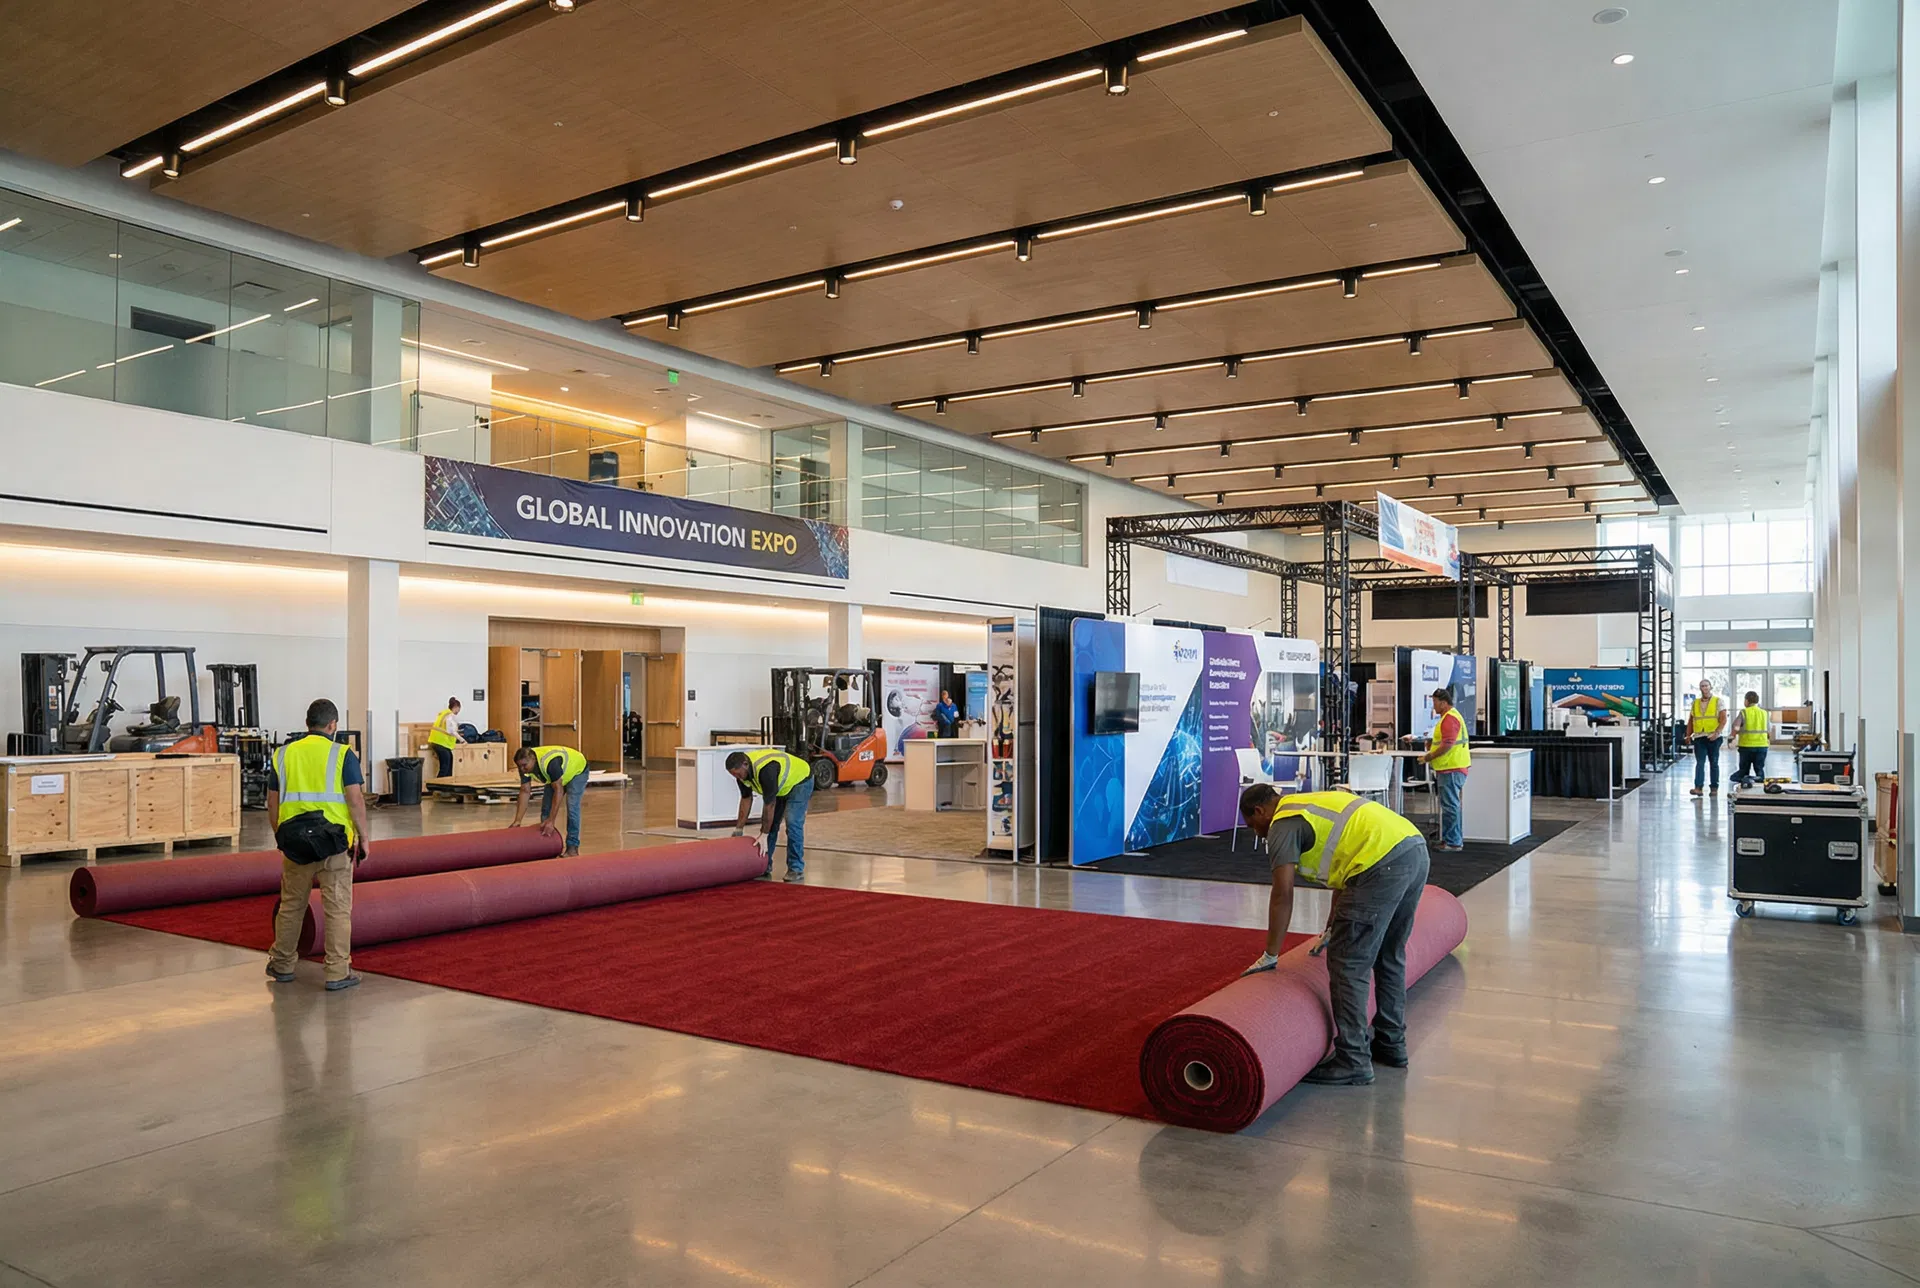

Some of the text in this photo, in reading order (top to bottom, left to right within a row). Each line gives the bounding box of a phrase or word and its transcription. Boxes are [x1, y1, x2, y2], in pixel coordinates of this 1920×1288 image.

[516, 494, 797, 555] GLOBAL INNOVATION EXPO
